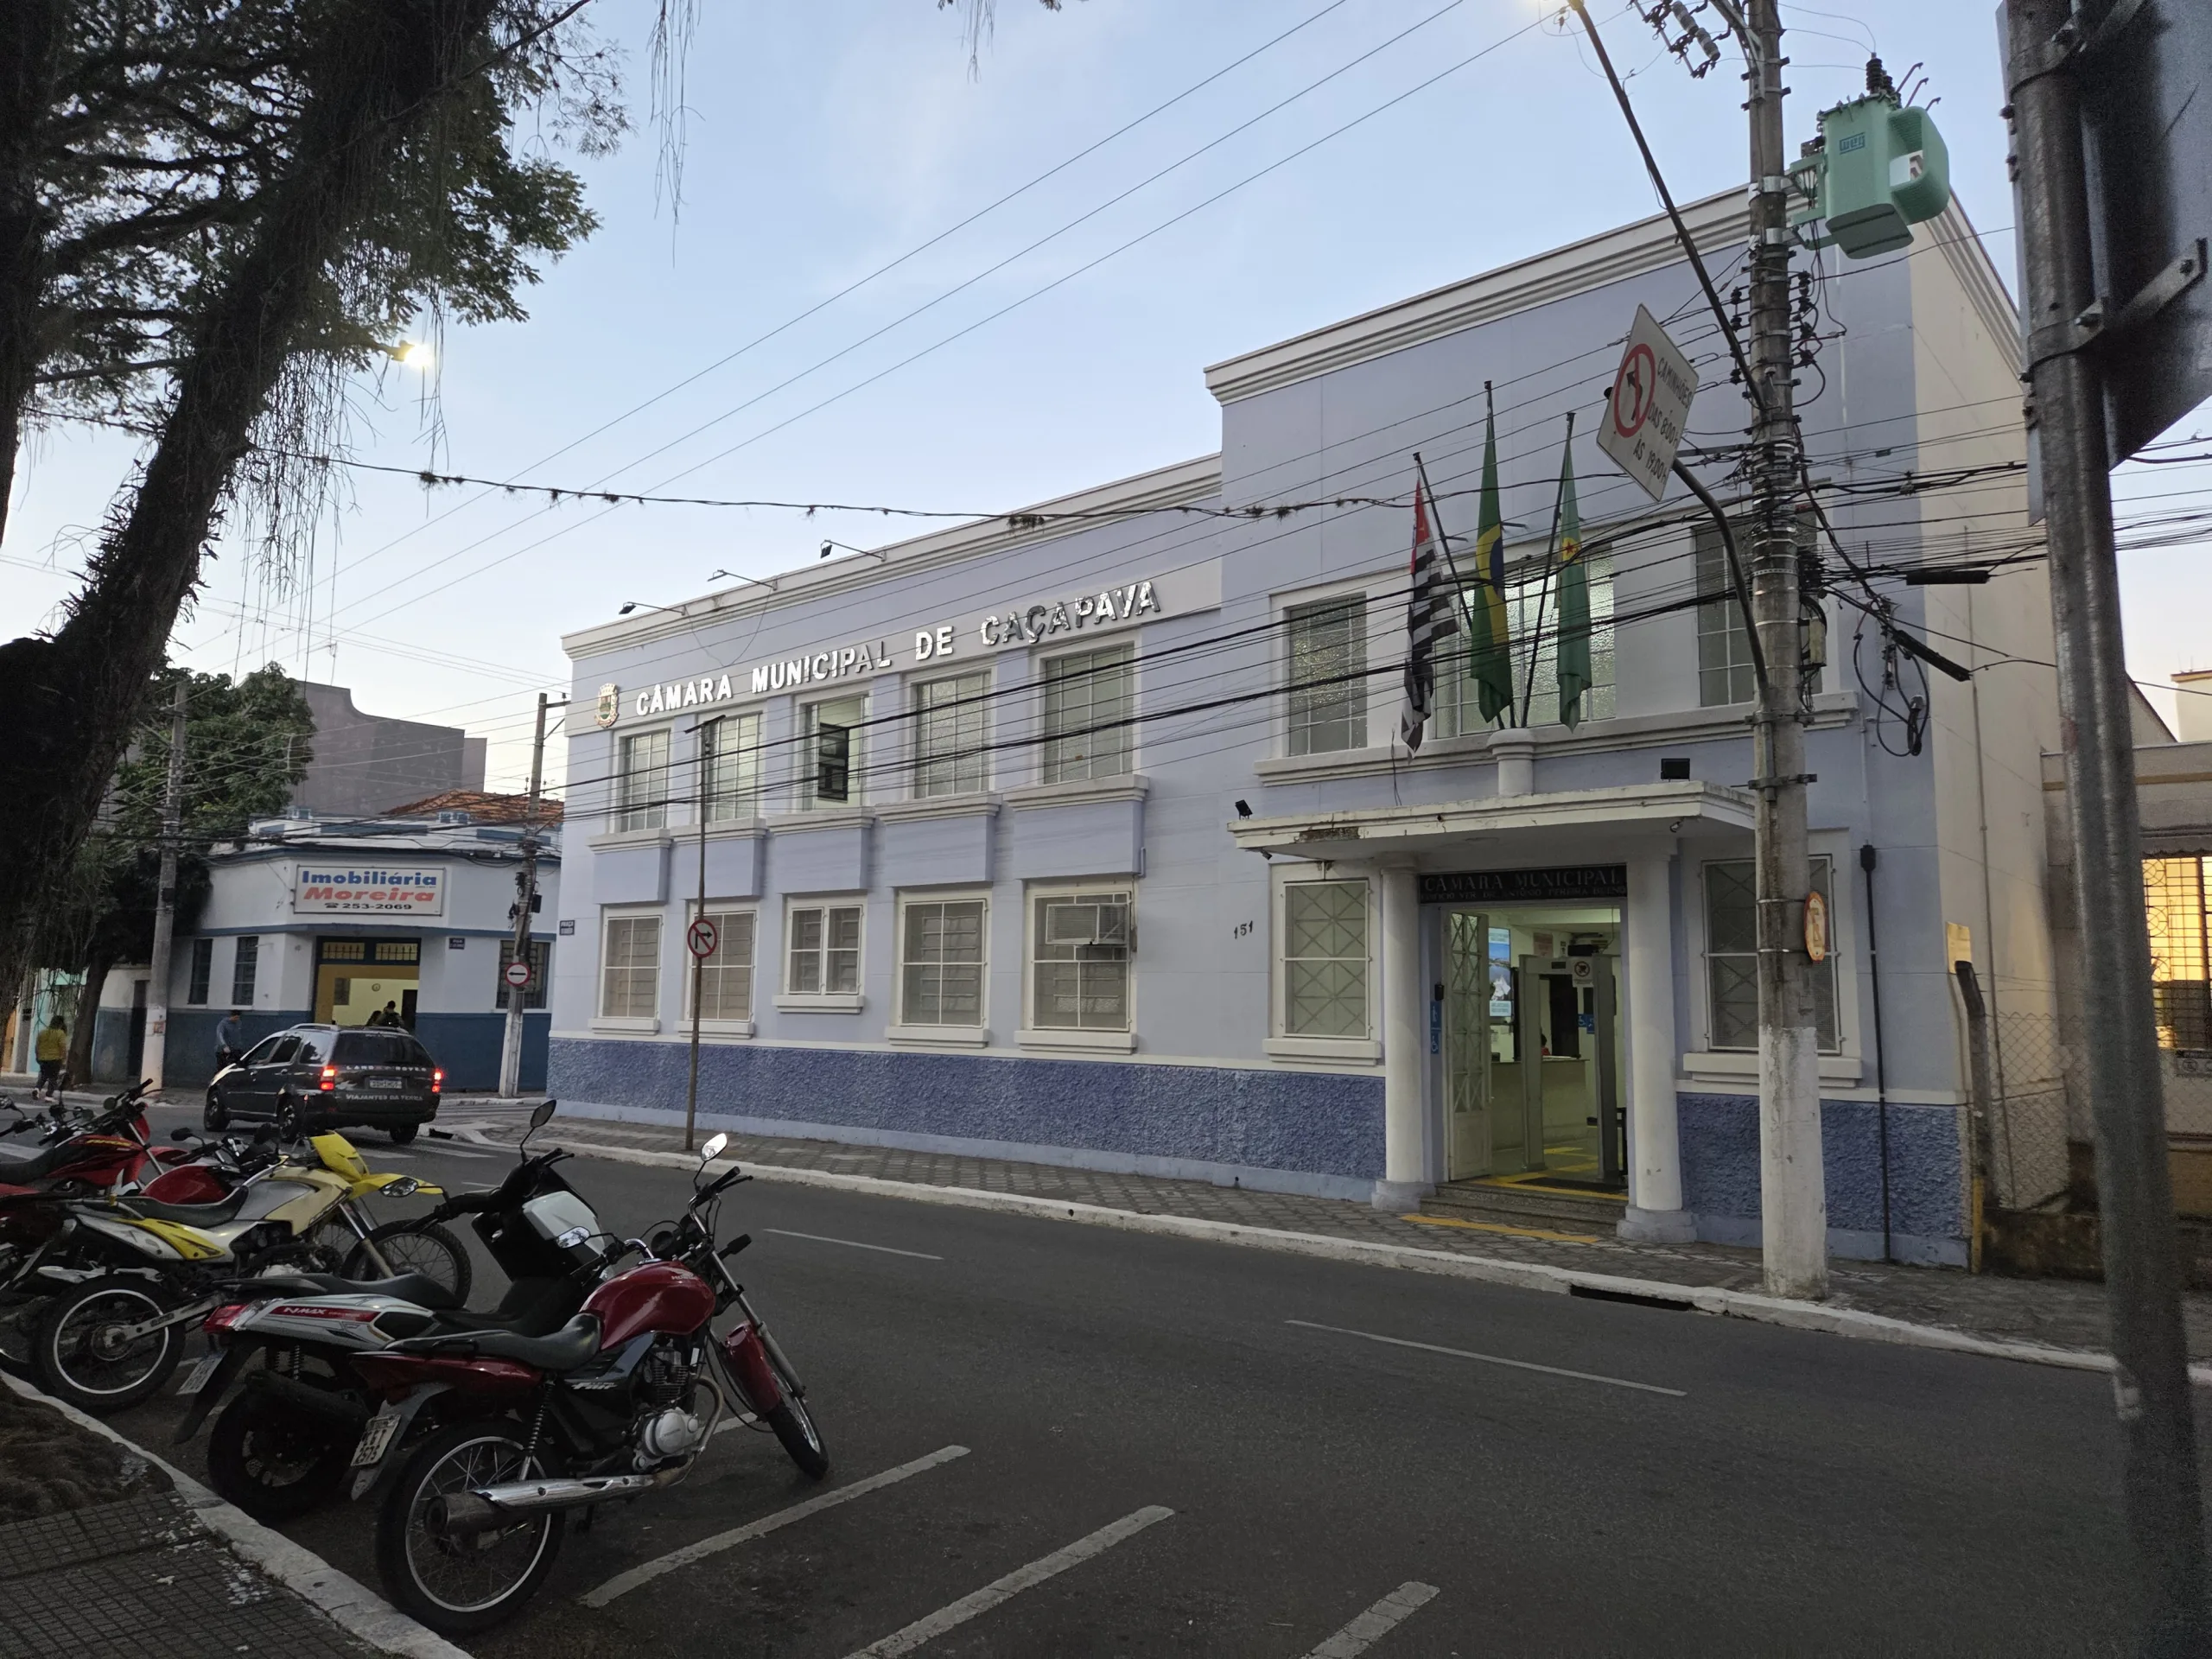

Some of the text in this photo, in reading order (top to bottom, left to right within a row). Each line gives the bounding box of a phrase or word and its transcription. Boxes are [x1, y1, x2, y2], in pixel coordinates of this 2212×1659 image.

[1657, 357, 1693, 410] CAMINHÕES
[1648, 401, 1662, 429] DAS
[636, 582, 1160, 716] CÂMARA MUNICIPAL DE CAÇAPAVA
[302, 871, 436, 885] Imobiliária
[1425, 868, 1619, 892] CÂMARA MUNICIPAL
[303, 887, 435, 901] Moreira
[1234, 920, 1253, 939] 151
[283, 1306, 327, 1315] NMAX
